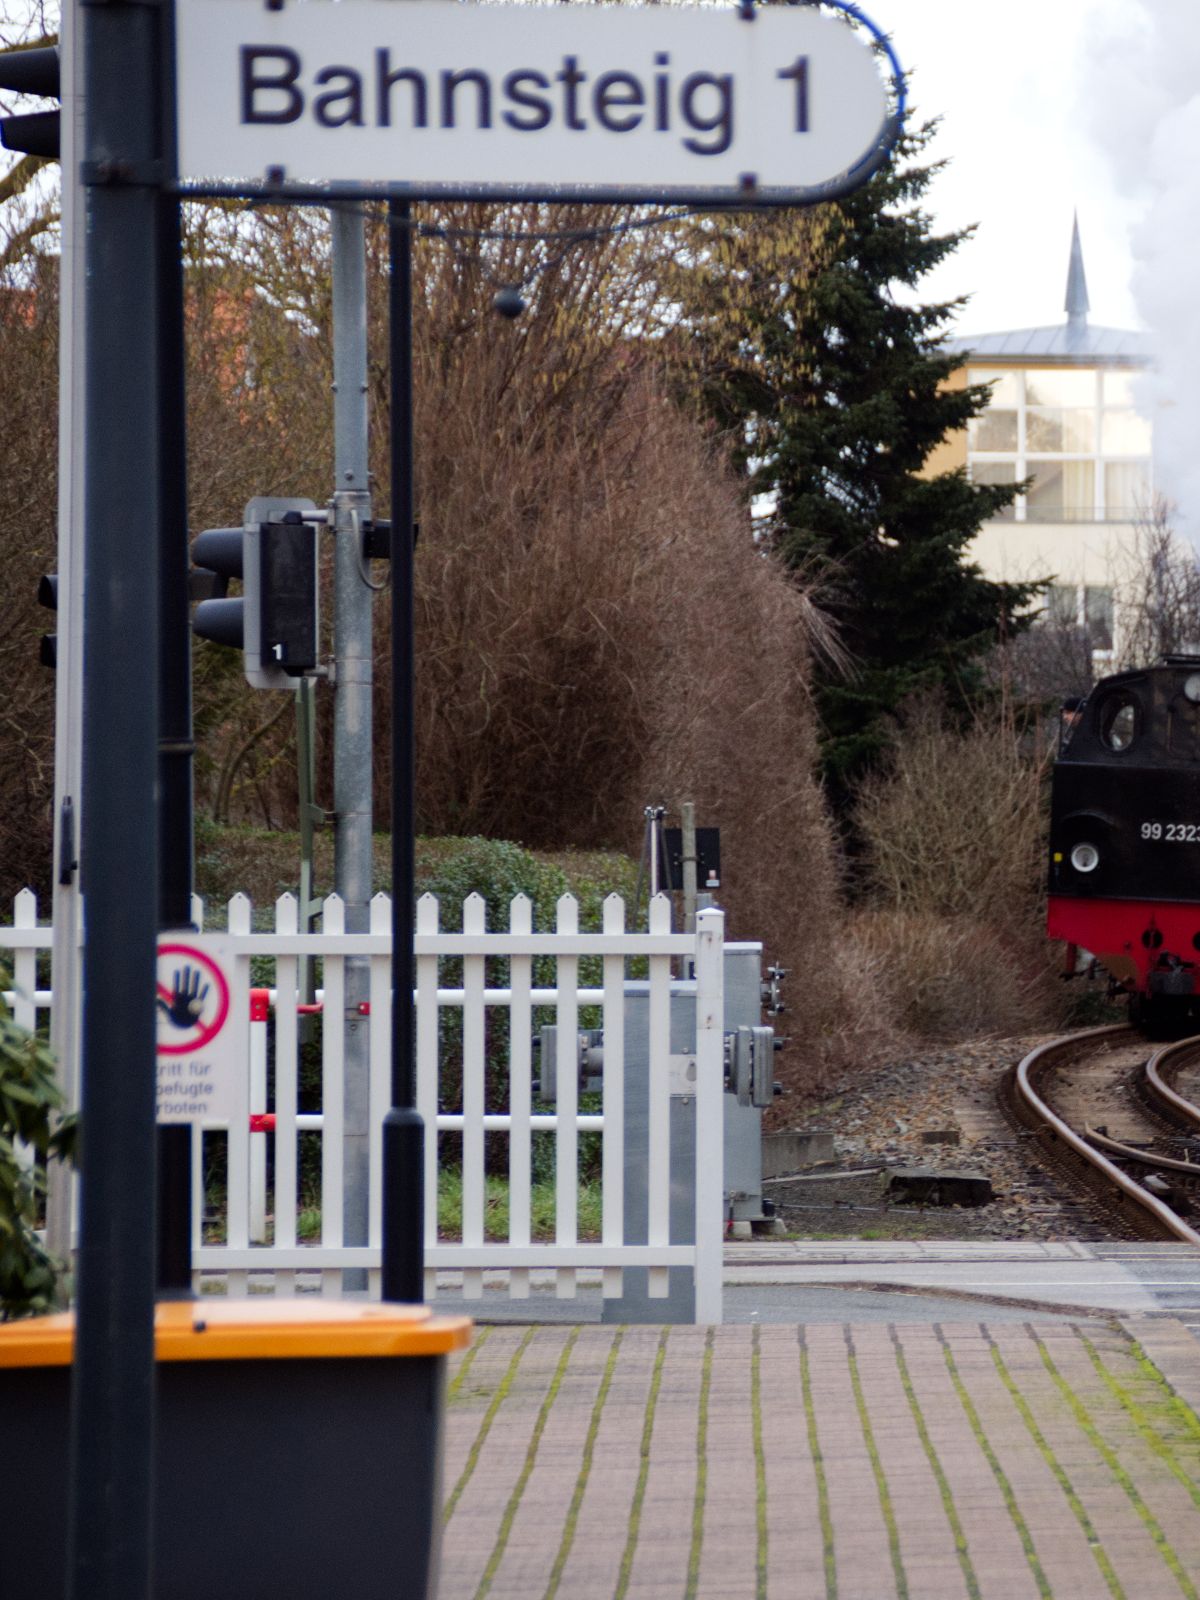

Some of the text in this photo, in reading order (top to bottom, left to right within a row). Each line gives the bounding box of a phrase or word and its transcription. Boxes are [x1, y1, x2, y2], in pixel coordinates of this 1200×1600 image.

[238, 43, 812, 156] Bahnsteig 1
[272, 643, 282, 660] 1
[1141, 822, 1162, 840] 99
[157, 1062, 182, 1076] ritt
[156, 1081, 214, 1098] efugte
[156, 1101, 208, 1115] rboten
